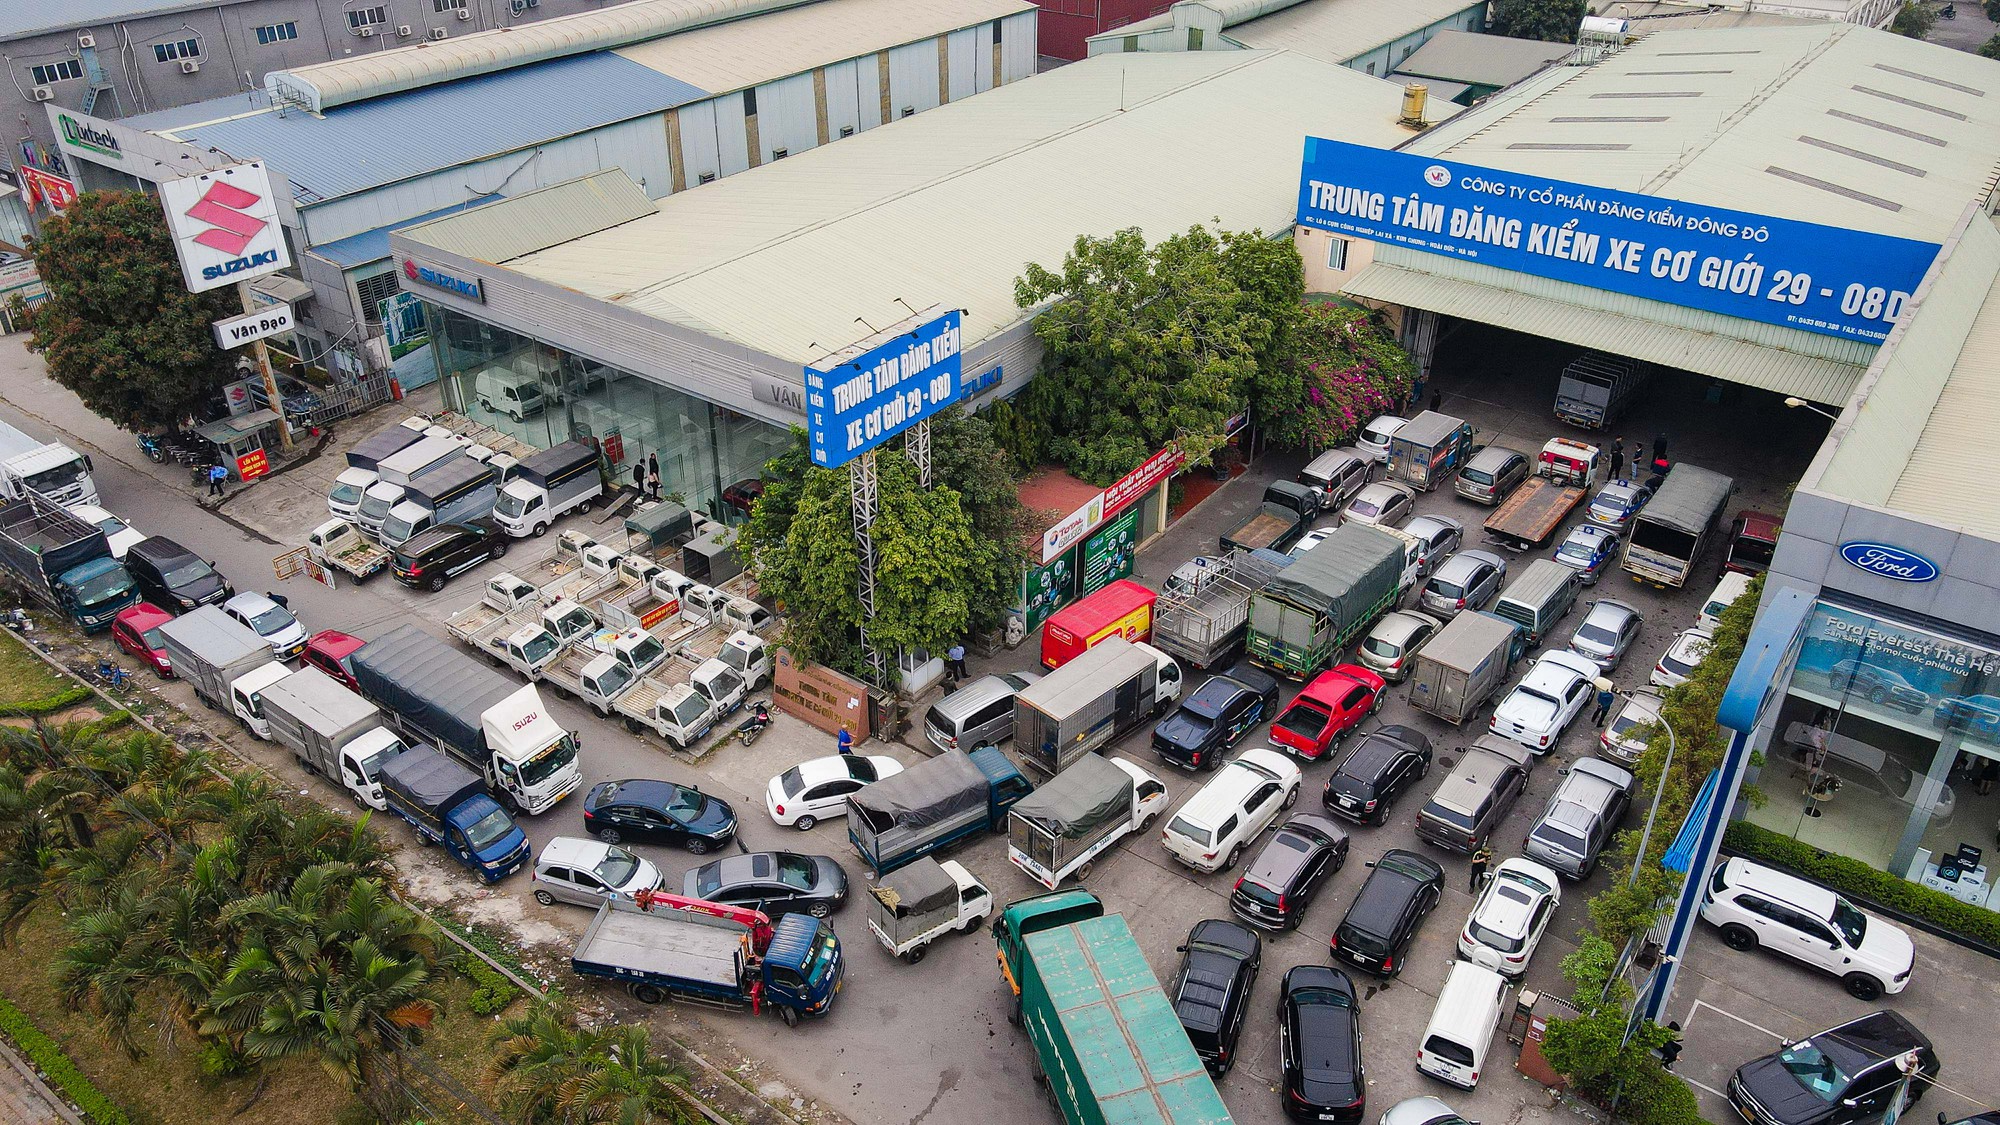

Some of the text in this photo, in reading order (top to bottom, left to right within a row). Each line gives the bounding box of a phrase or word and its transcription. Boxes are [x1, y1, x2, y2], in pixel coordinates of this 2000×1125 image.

[1461, 176, 1770, 243] CÔNG TY CỔ PHẦN ĐĂNG KIỂM ĐÔNG ĐÔ
[202, 249, 278, 280] SUZUKI
[1309, 179, 1384, 223] TRUNG
[1392, 192, 1446, 235] TÂM
[1449, 206, 1522, 249] ĐĂNG
[1527, 218, 1600, 264] KIỂM
[1603, 237, 1645, 274] XE
[1650, 246, 1696, 282] CƠ
[1698, 253, 1765, 297] GIỚI
[1767, 270, 1811, 306] 29
[1840, 282, 1911, 324] 08D
[419, 266, 479, 298] SUZUKI
[230, 316, 286, 340] Vân Đạo
[832, 320, 960, 415] TRUNG TÂM ĐĂNG KIỂM
[961, 364, 1003, 400] ZUKI
[771, 385, 802, 410] VÂN
[846, 416, 864, 451] XE
[865, 402, 883, 441] CƠ
[883, 391, 906, 432] GIỚI
[907, 387, 922, 418] 29
[929, 372, 951, 406] 08D
[814, 412, 823, 426] XE
[1060, 517, 1083, 536] TOTAL
[1857, 549, 1919, 579] Ford
[1826, 615, 1865, 636] Ford
[1866, 628, 1931, 655] Everest
[1969, 657, 1994, 676] Hệ
[512, 711, 538, 732] ISUZU
